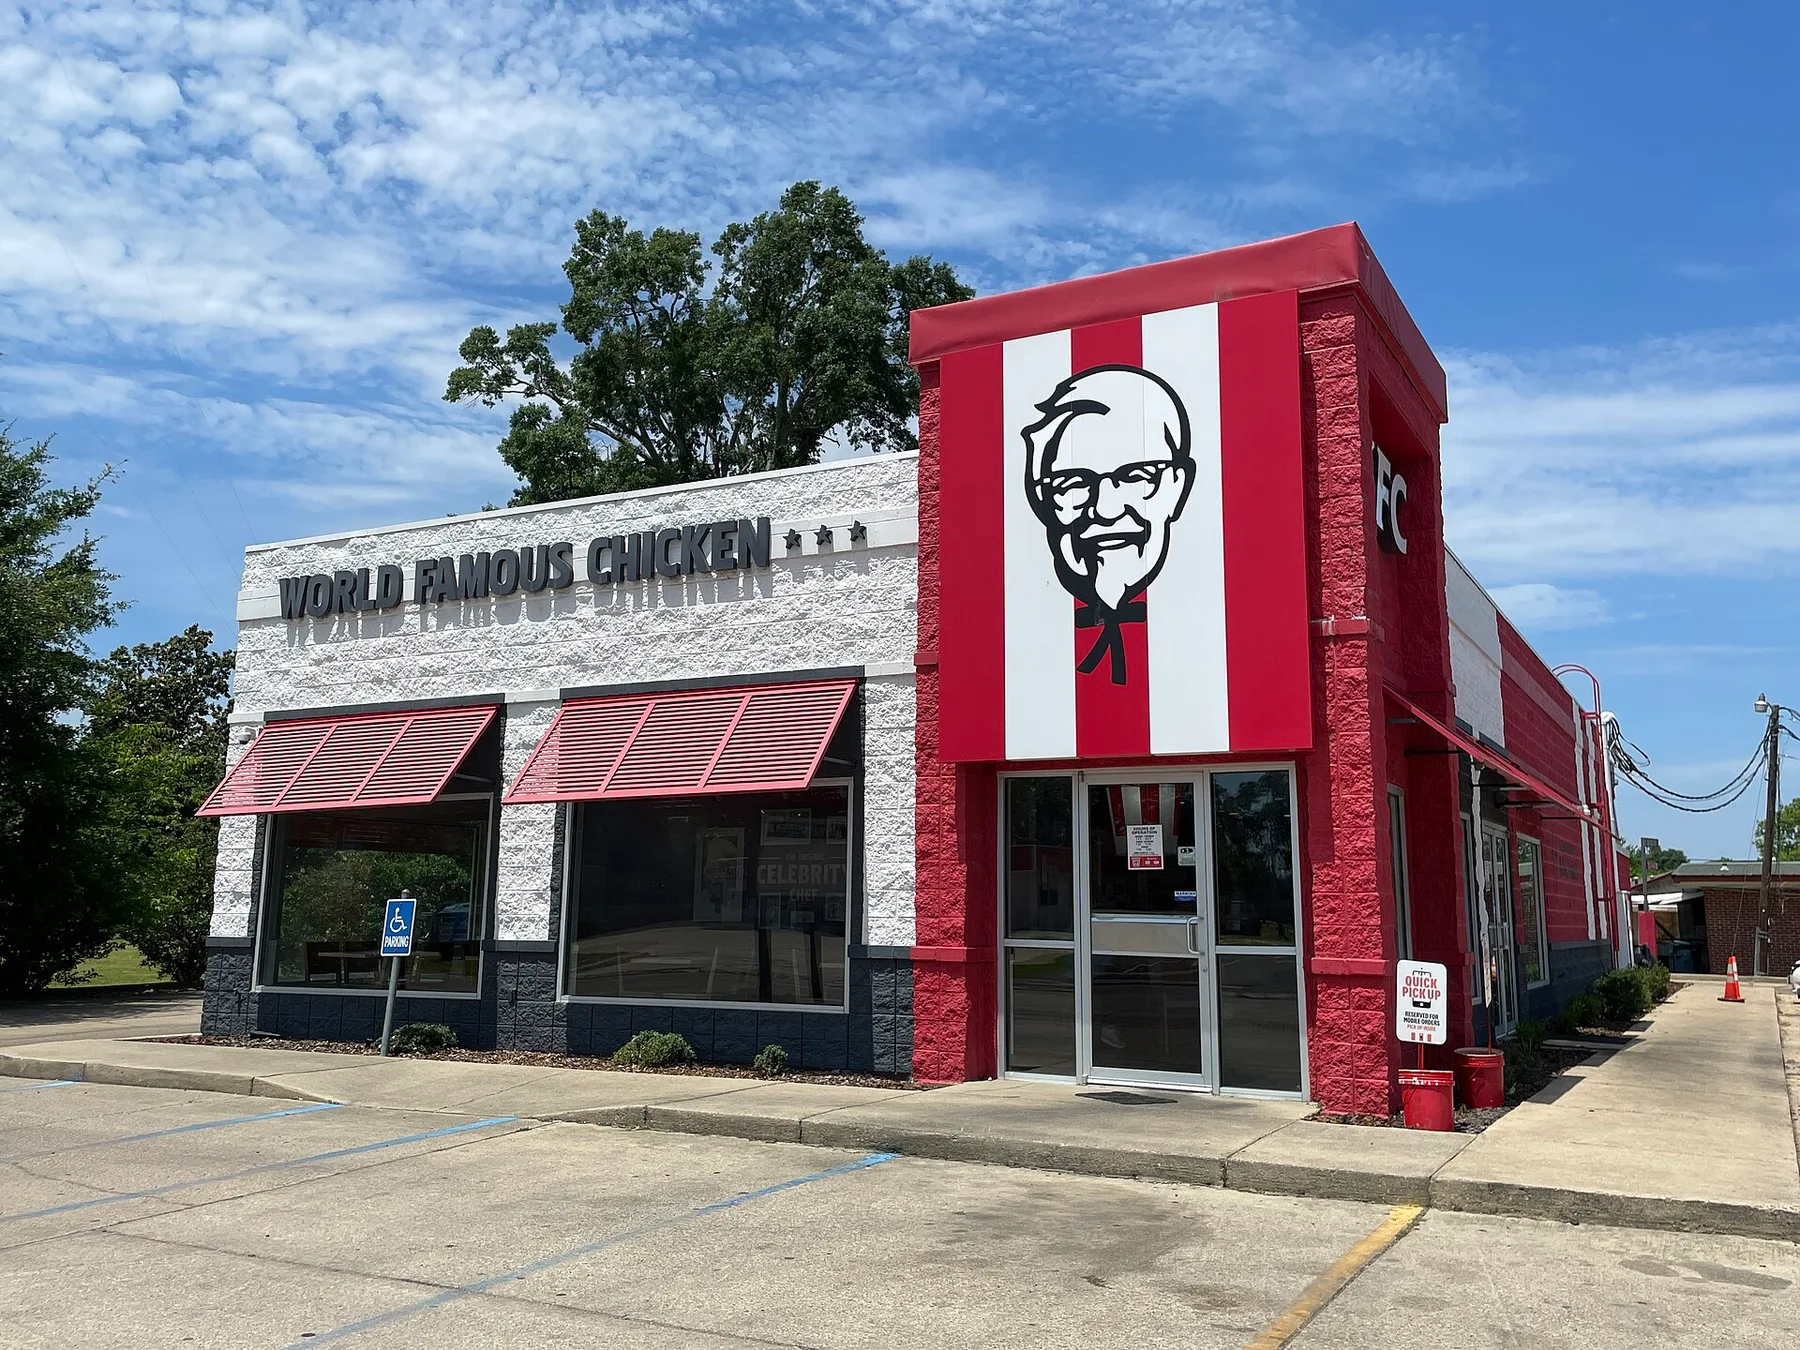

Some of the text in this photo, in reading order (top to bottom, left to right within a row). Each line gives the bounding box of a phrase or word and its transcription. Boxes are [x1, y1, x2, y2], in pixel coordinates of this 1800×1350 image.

[1371, 441, 1408, 555] FC
[280, 517, 771, 619] WORLD FAMOUS CHICKEN
[789, 888, 818, 902] CHEF
[384, 935, 409, 948] PARKING
[1405, 976, 1437, 989] QUICK
